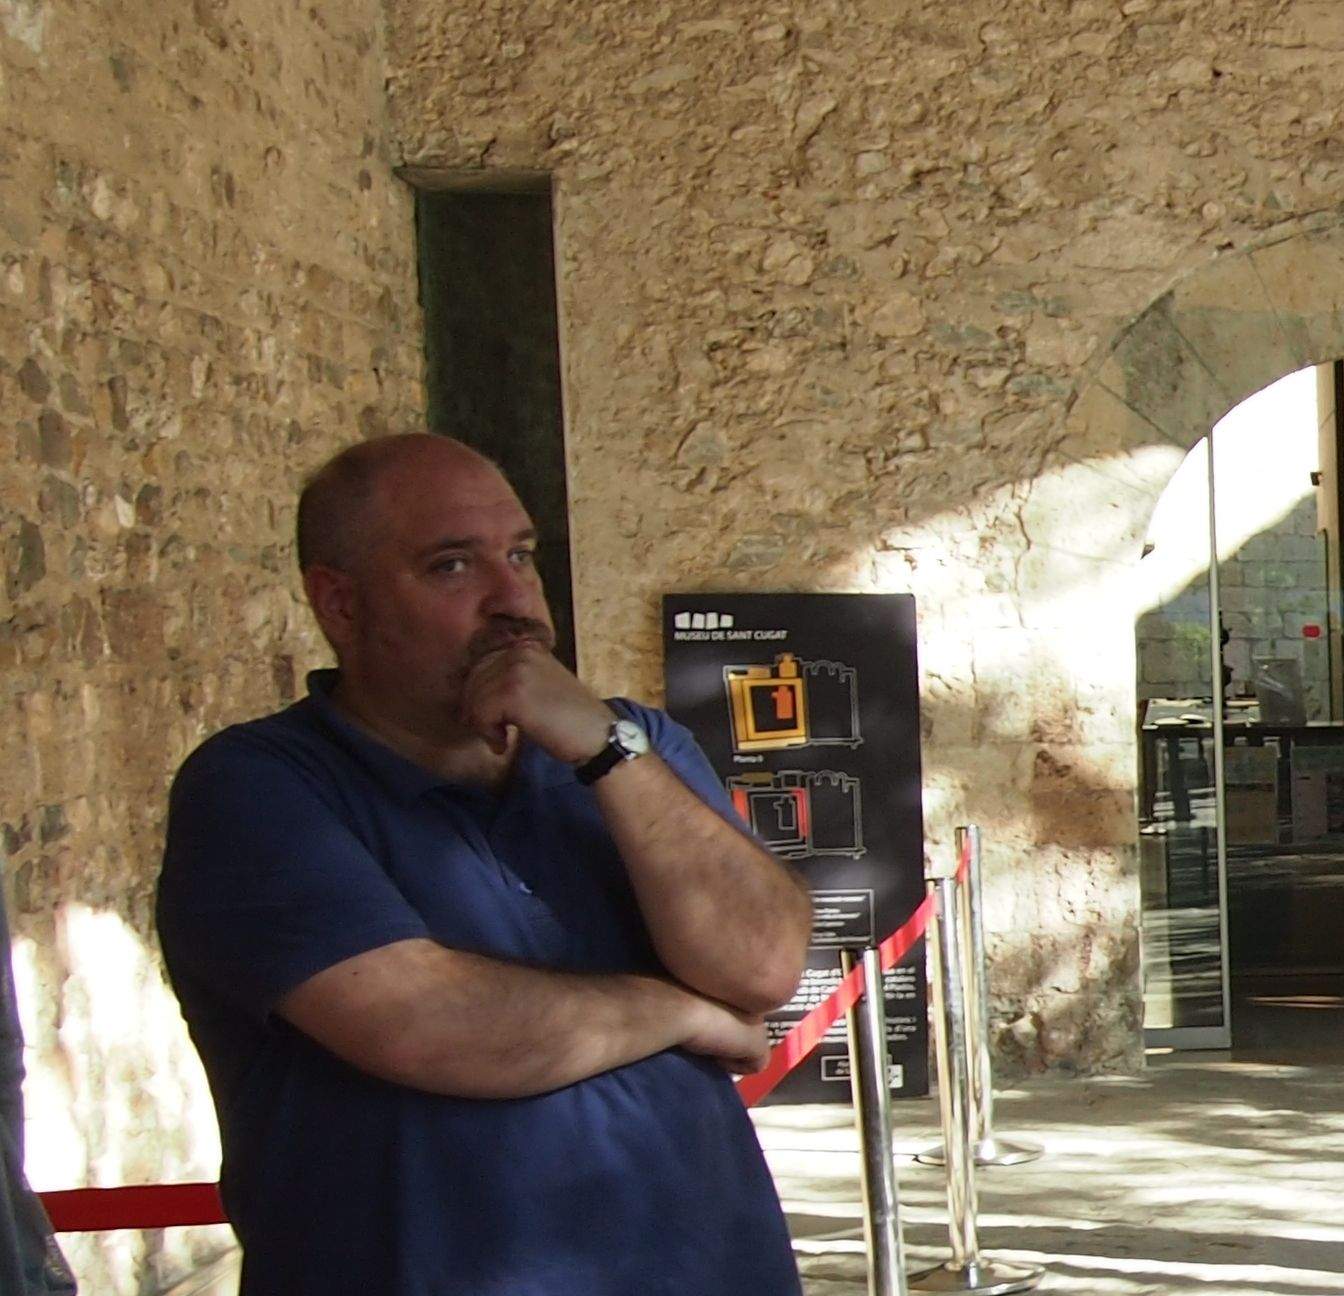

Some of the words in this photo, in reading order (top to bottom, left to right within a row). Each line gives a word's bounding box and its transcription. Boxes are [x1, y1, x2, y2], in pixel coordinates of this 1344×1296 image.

[674, 631, 709, 640] MUSEU
[711, 631, 725, 640] DE
[726, 630, 752, 640] SANT
[753, 630, 787, 640] CUGAT
